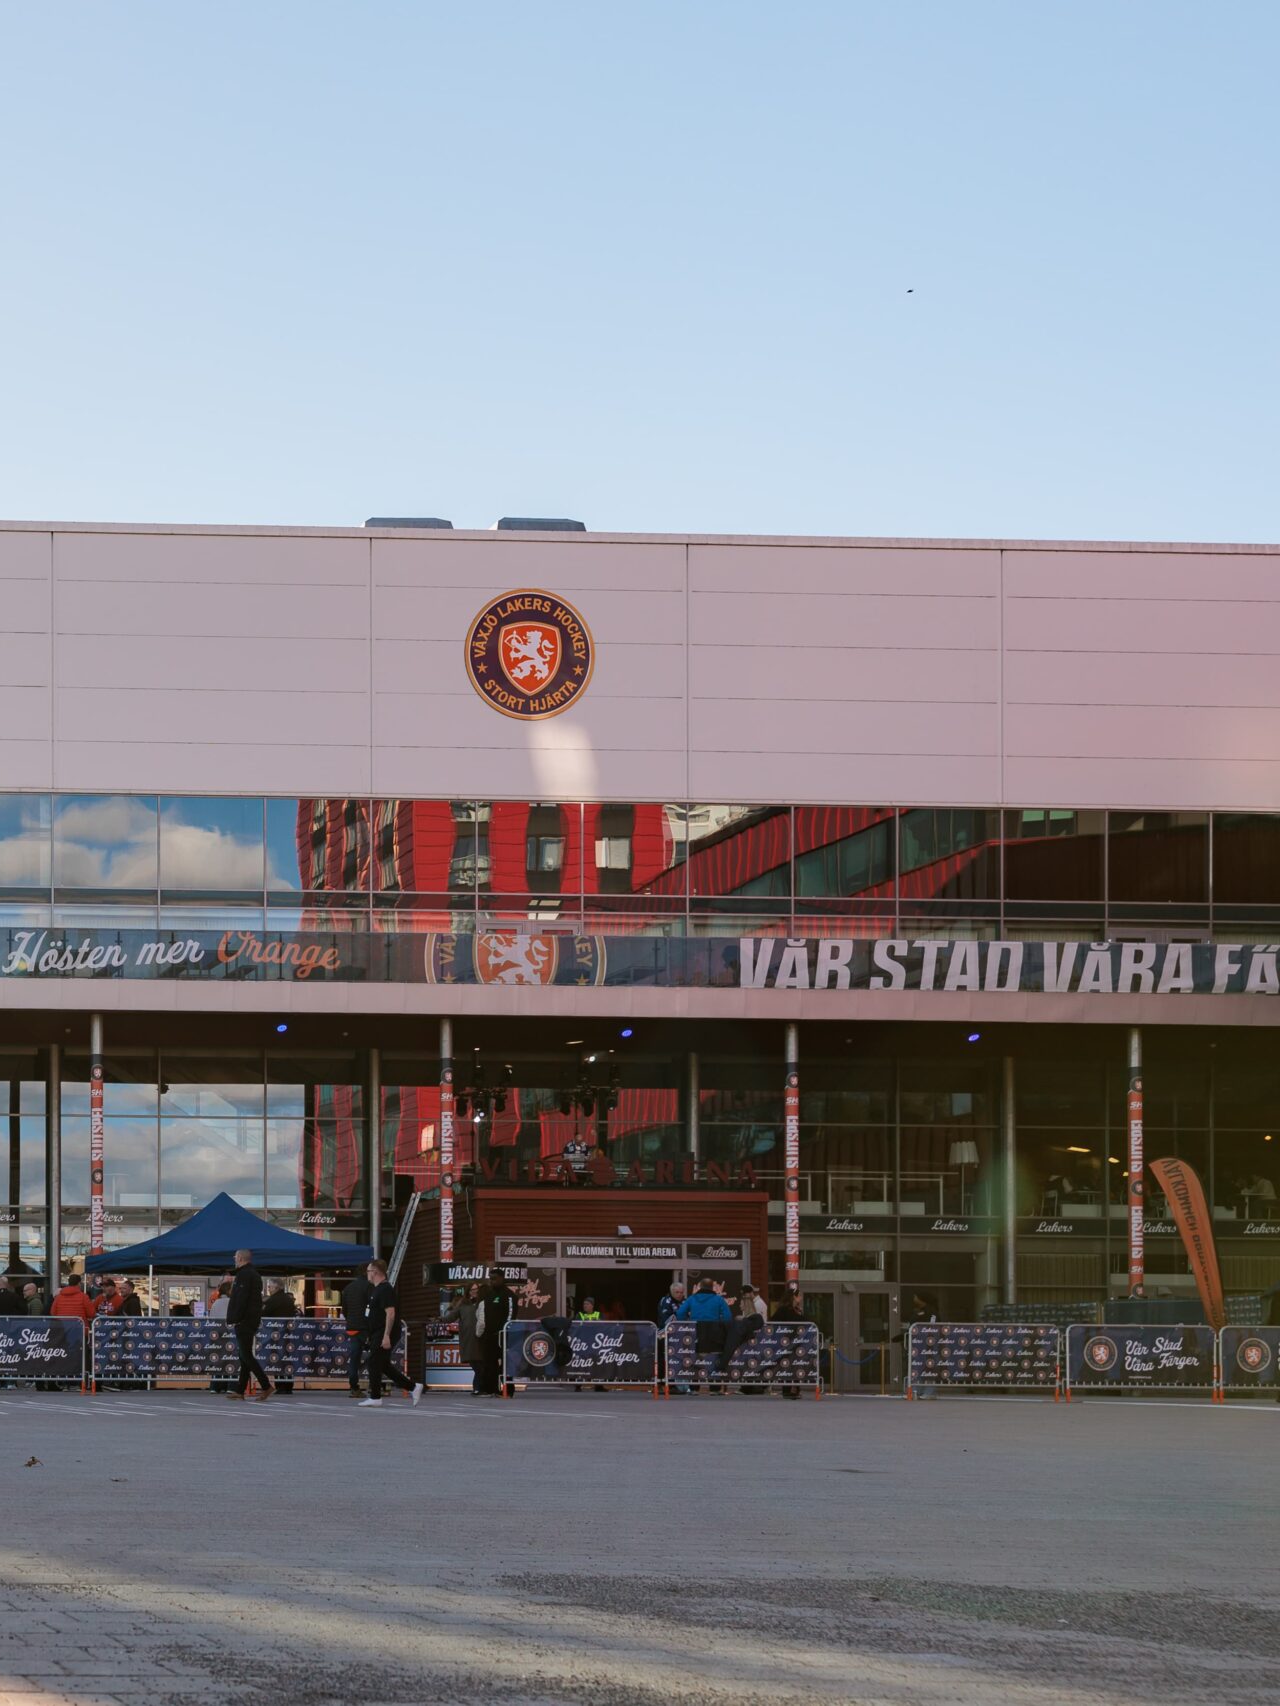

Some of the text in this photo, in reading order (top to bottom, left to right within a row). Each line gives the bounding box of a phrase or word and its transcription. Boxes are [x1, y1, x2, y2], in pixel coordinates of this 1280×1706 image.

[473, 597, 586, 660] VÄXJÖ LAKERS HOCKEY
[484, 680, 578, 711] STORT HJÄRTA
[1, 931, 127, 973] Hösten
[135, 937, 205, 966] mer
[216, 930, 342, 977] Orange
[739, 937, 853, 989] VÅR
[869, 938, 1023, 992] STAD
[1042, 941, 1195, 993] VÅRA
[628, 1160, 758, 1184] ARENA
[298, 1212, 336, 1224] Lakers
[826, 1219, 863, 1231] Lakers
[931, 1219, 969, 1231] Lakers
[1036, 1222, 1073, 1233] Lakers
[1142, 1222, 1177, 1234] Lakers
[1244, 1223, 1280, 1234] Lakers
[566, 1244, 676, 1258] VÄLKOMMEN TILL VIDA ARENA
[448, 1265, 484, 1280] VÄXJÖ
[485, 1267, 520, 1279] LERS
[18, 1328, 51, 1345] Stad
[592, 1332, 624, 1348] Stad
[24, 1344, 68, 1361] Färger
[1125, 1337, 1184, 1356] Vår Stad
[596, 1349, 640, 1365] Färger
[1125, 1352, 1200, 1372] Våra Färger
